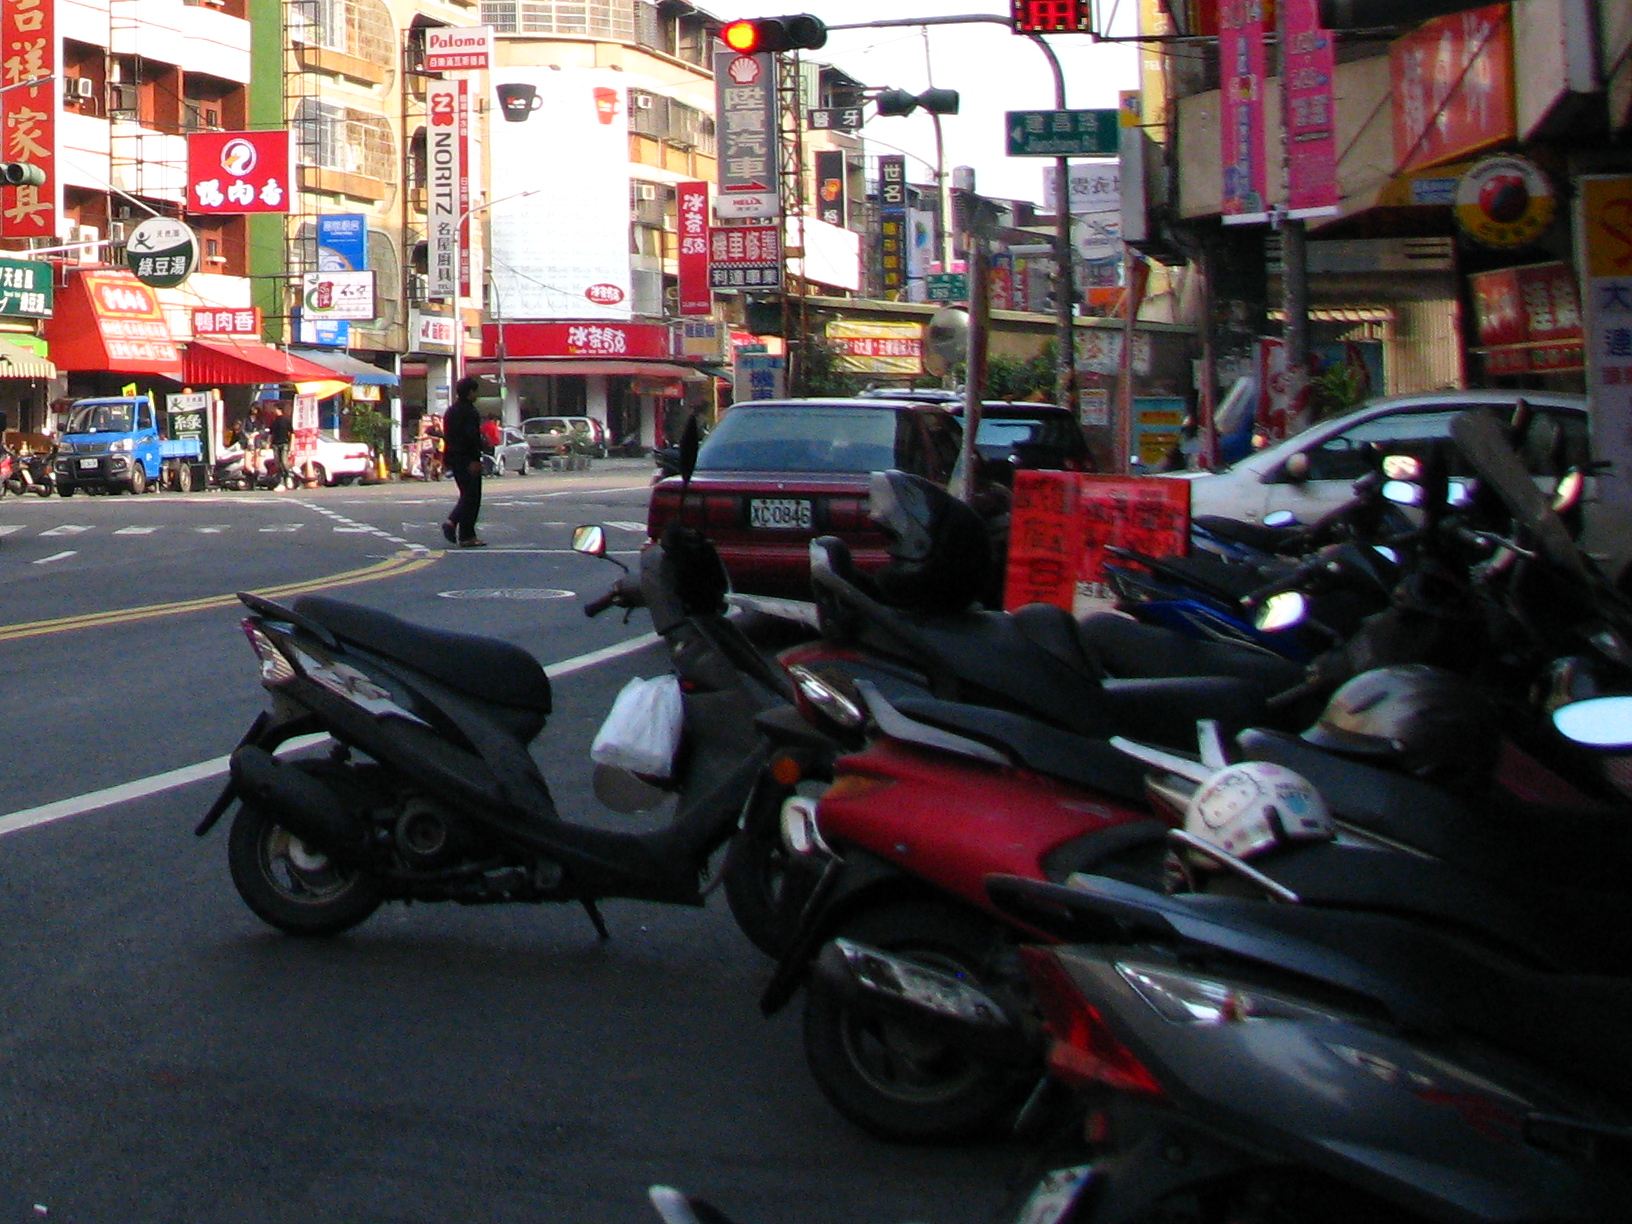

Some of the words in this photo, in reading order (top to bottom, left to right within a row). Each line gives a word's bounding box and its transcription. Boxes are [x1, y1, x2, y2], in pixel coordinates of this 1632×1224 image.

[429, 33, 486, 49] Paloma
[434, 132, 454, 216] NORITZ
[137, 256, 186, 277] 綠豆湯
[194, 310, 256, 333] 鴨肉香
